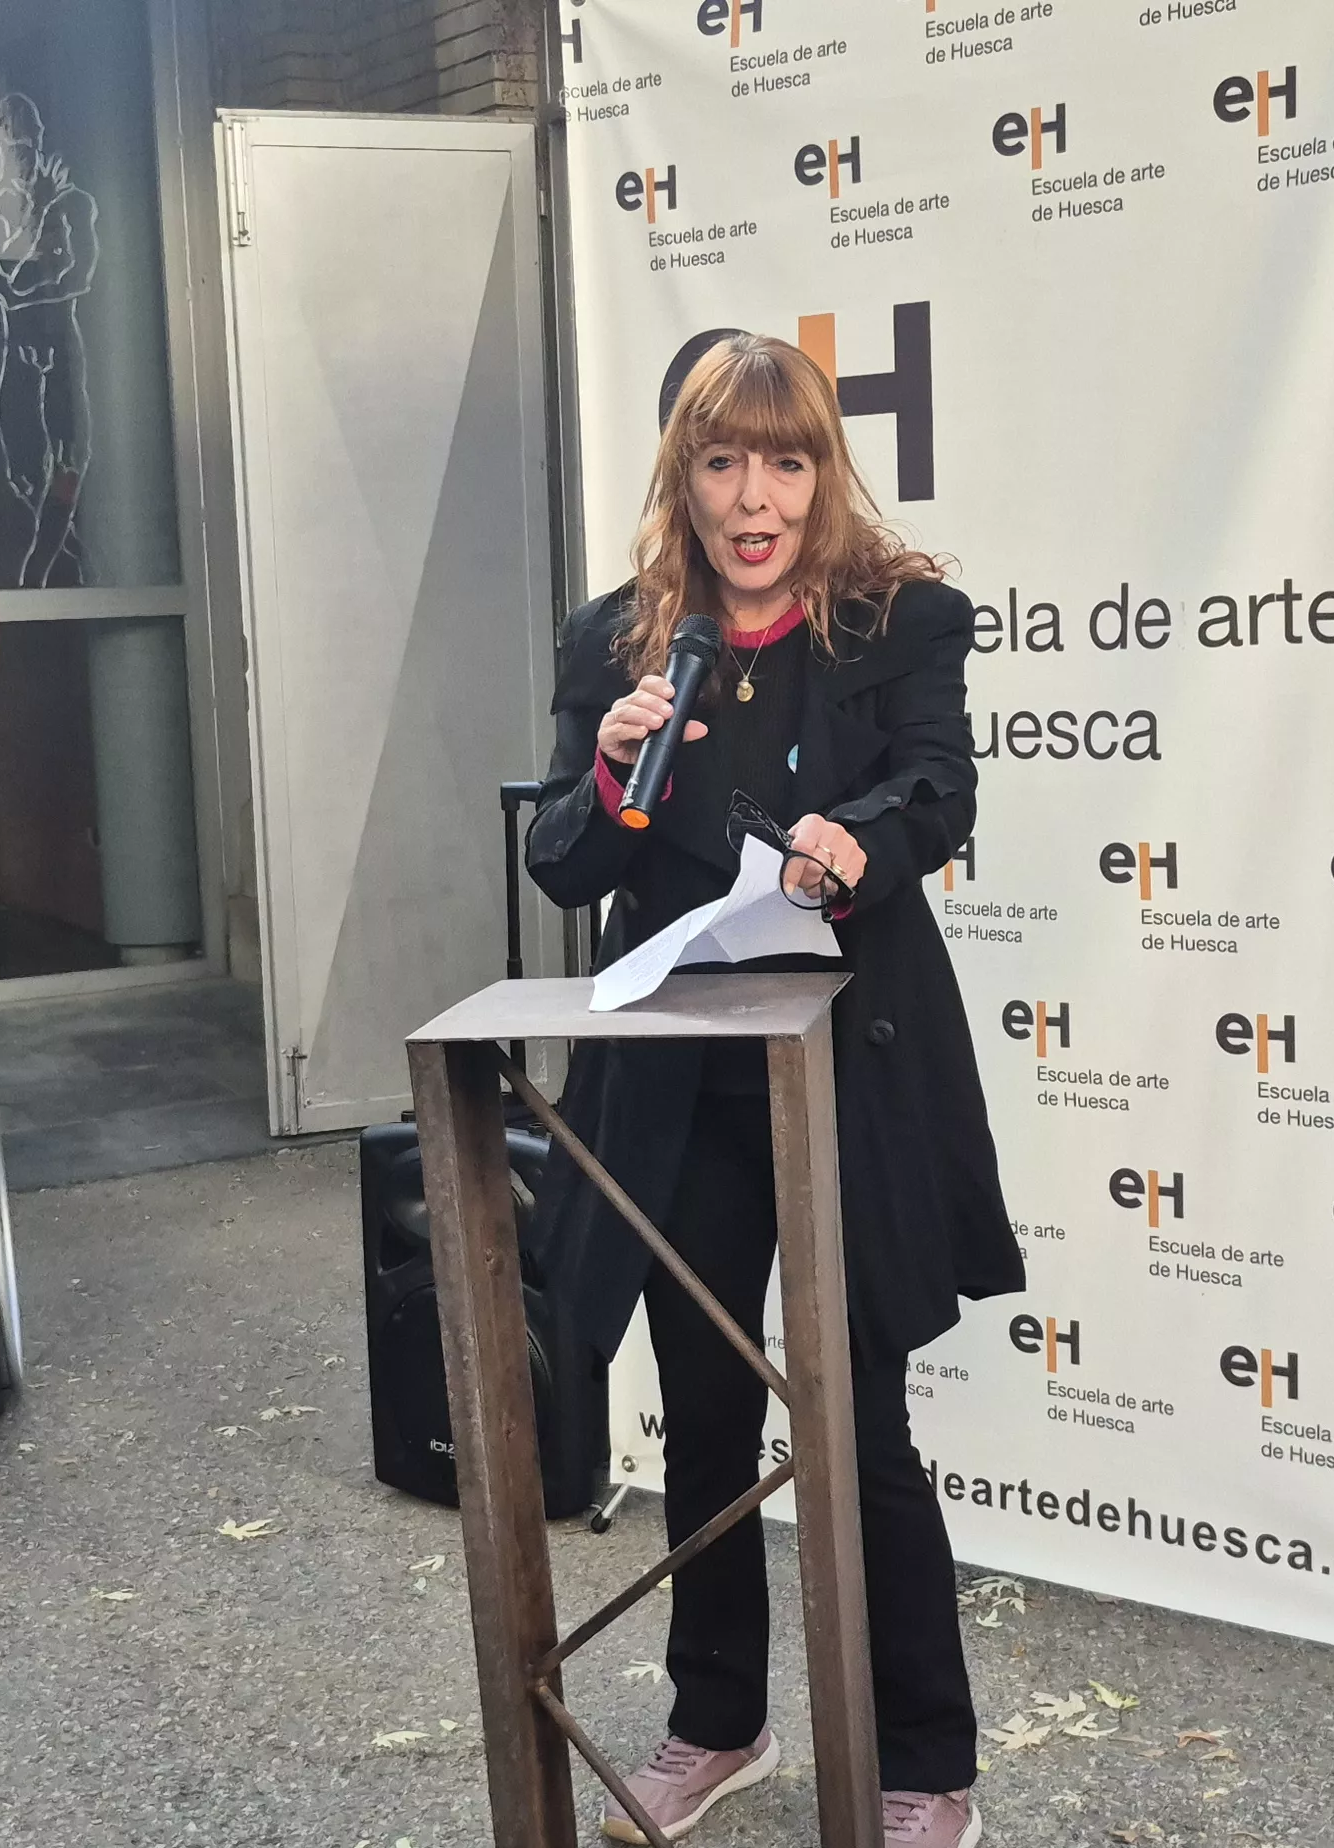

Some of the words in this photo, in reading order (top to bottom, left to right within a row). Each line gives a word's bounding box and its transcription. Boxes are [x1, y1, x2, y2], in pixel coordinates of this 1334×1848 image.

[926, 13, 989, 38] Escuela
[994, 8, 1015, 26] de
[1021, 2, 1053, 21] arte
[1140, 8, 1161, 26] de
[1168, 0, 1236, 21] Huesca
[731, 49, 788, 72] Escuela
[793, 45, 812, 61] de
[817, 40, 847, 57] arte
[926, 47, 946, 64] de
[951, 37, 1013, 60] Huesca
[563, 81, 608, 100] scuela
[613, 77, 631, 92] de
[636, 73, 661, 89] arte
[732, 80, 749, 97] de
[754, 73, 810, 93] Huesca
[578, 104, 629, 121] Huesca
[1258, 137, 1326, 164] Escuela
[1032, 172, 1098, 195] Escuela
[1103, 167, 1125, 185] de
[1131, 163, 1165, 182] arte
[1257, 173, 1280, 191] de
[831, 201, 889, 223] Escuela
[894, 197, 914, 214] de
[919, 194, 949, 211] arte
[1032, 204, 1053, 222] de
[1059, 198, 1123, 219] Huesca
[649, 227, 704, 247] Escuela
[708, 224, 725, 240] de
[730, 220, 757, 237] arte
[831, 232, 850, 248] de
[855, 226, 913, 245] Huesca
[650, 255, 666, 271] de
[671, 251, 725, 268] Huesca
[1089, 582, 1171, 651] de
[969, 708, 1162, 761] uesca
[945, 899, 1002, 917] Escuela
[1007, 903, 1025, 918] de
[1030, 905, 1057, 920] arte
[1141, 909, 1212, 926] Escuela
[1218, 911, 1240, 927] de
[1246, 913, 1280, 929] arte
[944, 923, 962, 939] de
[968, 924, 1022, 943] Huesca
[1142, 934, 1164, 950] de
[1171, 934, 1238, 953] Huesca
[1038, 1066, 1103, 1085] Escuela
[1109, 1071, 1131, 1086] de
[1137, 1074, 1169, 1090] arte
[1038, 1090, 1058, 1106] de
[1064, 1092, 1130, 1111] Huesca
[1258, 1082, 1330, 1103] Escuela
[1258, 1107, 1280, 1124] de
[1034, 1225, 1065, 1240] arte
[1149, 1236, 1216, 1259] Escuela
[1222, 1245, 1244, 1262] de
[1250, 1251, 1284, 1267] arte
[1149, 1261, 1170, 1277] de
[1177, 1264, 1242, 1287] Huesca
[916, 1360, 934, 1375] de
[940, 1366, 968, 1381] arte
[1047, 1380, 1110, 1405] Escuela
[1116, 1393, 1136, 1409] de
[1142, 1399, 1174, 1416] arte
[1047, 1405, 1067, 1421] de
[1073, 1408, 1135, 1433] Huesca
[1262, 1415, 1332, 1443] Escuela
[1261, 1442, 1283, 1459] de
